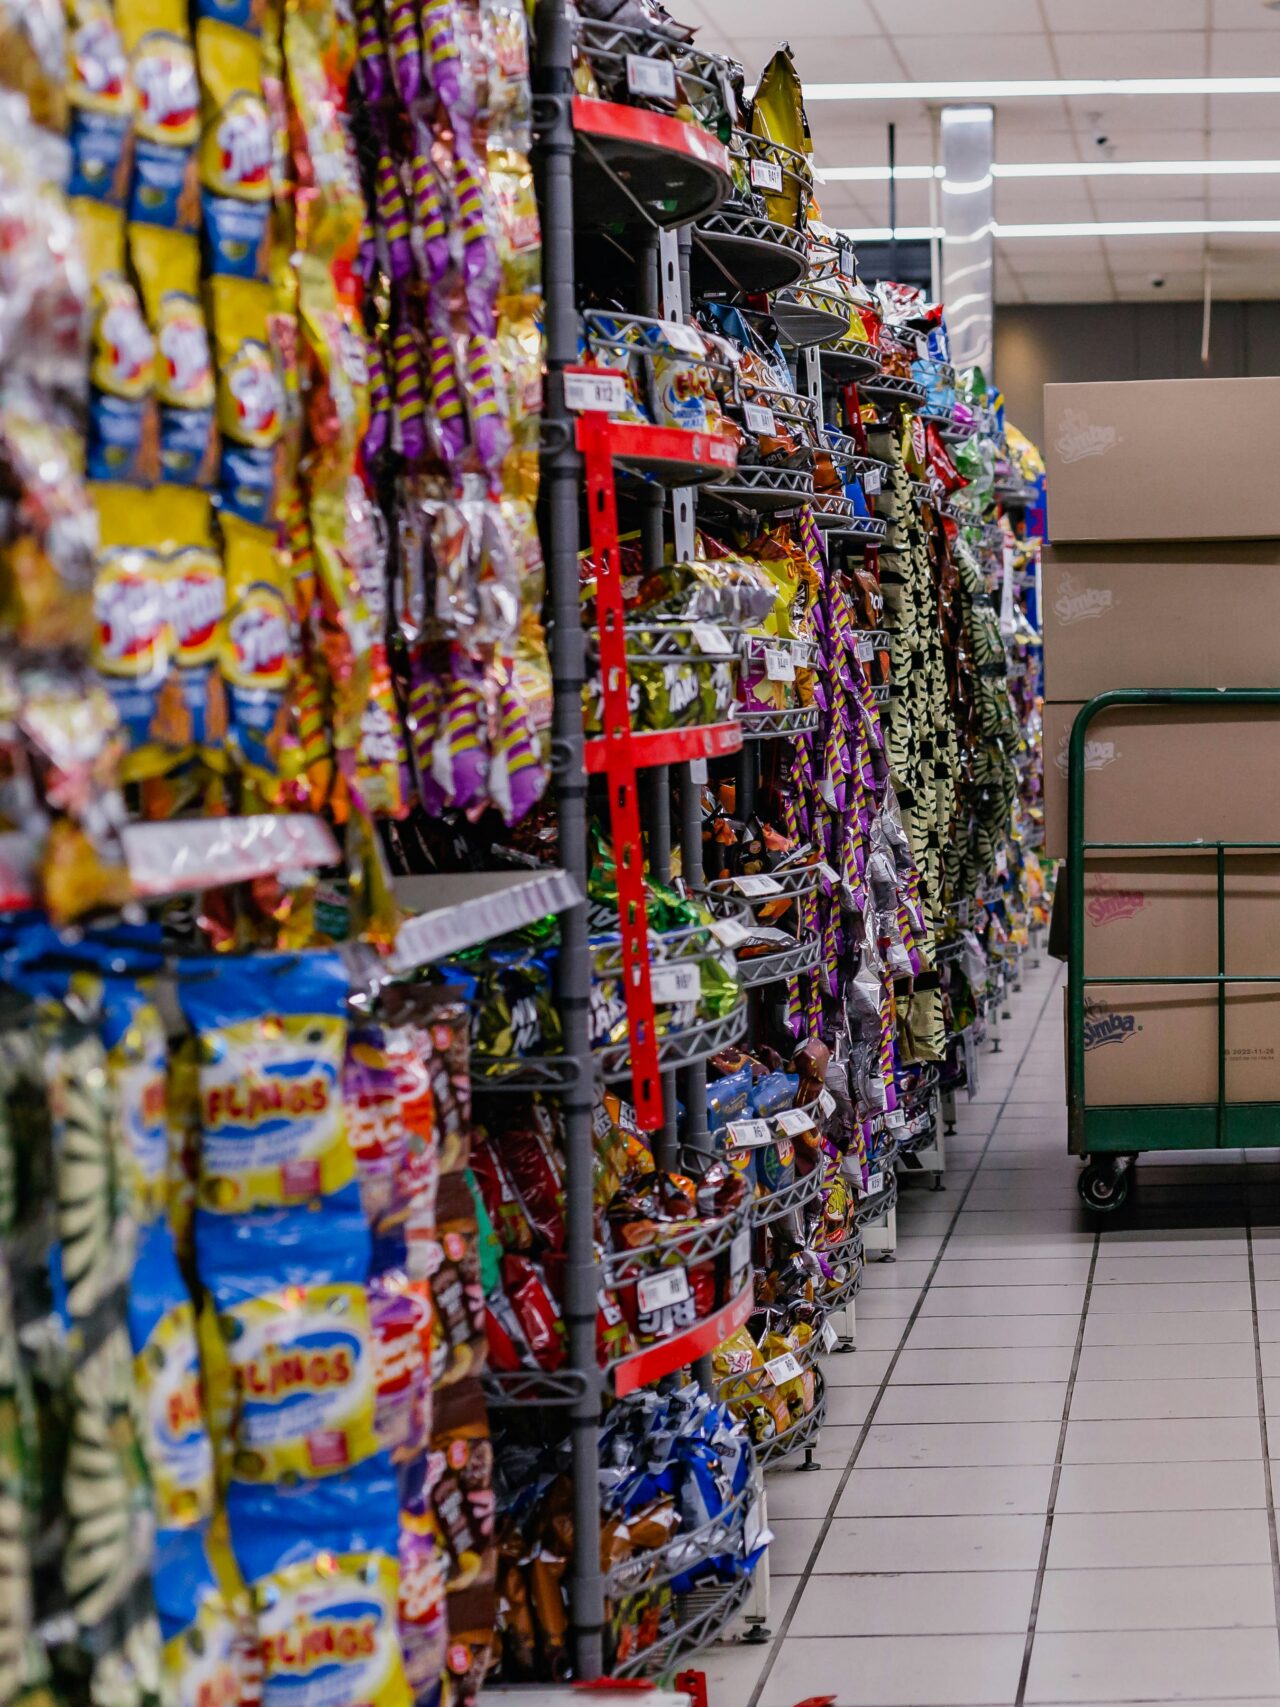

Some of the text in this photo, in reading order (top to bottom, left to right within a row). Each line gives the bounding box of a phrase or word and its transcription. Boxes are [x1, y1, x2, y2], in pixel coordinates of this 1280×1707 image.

[1056, 425, 1115, 460] Simba
[1055, 588, 1112, 622] Simba
[1087, 890, 1145, 923] Simba
[1083, 1013, 1135, 1047] Simba
[208, 1077, 328, 1127] FLINGS
